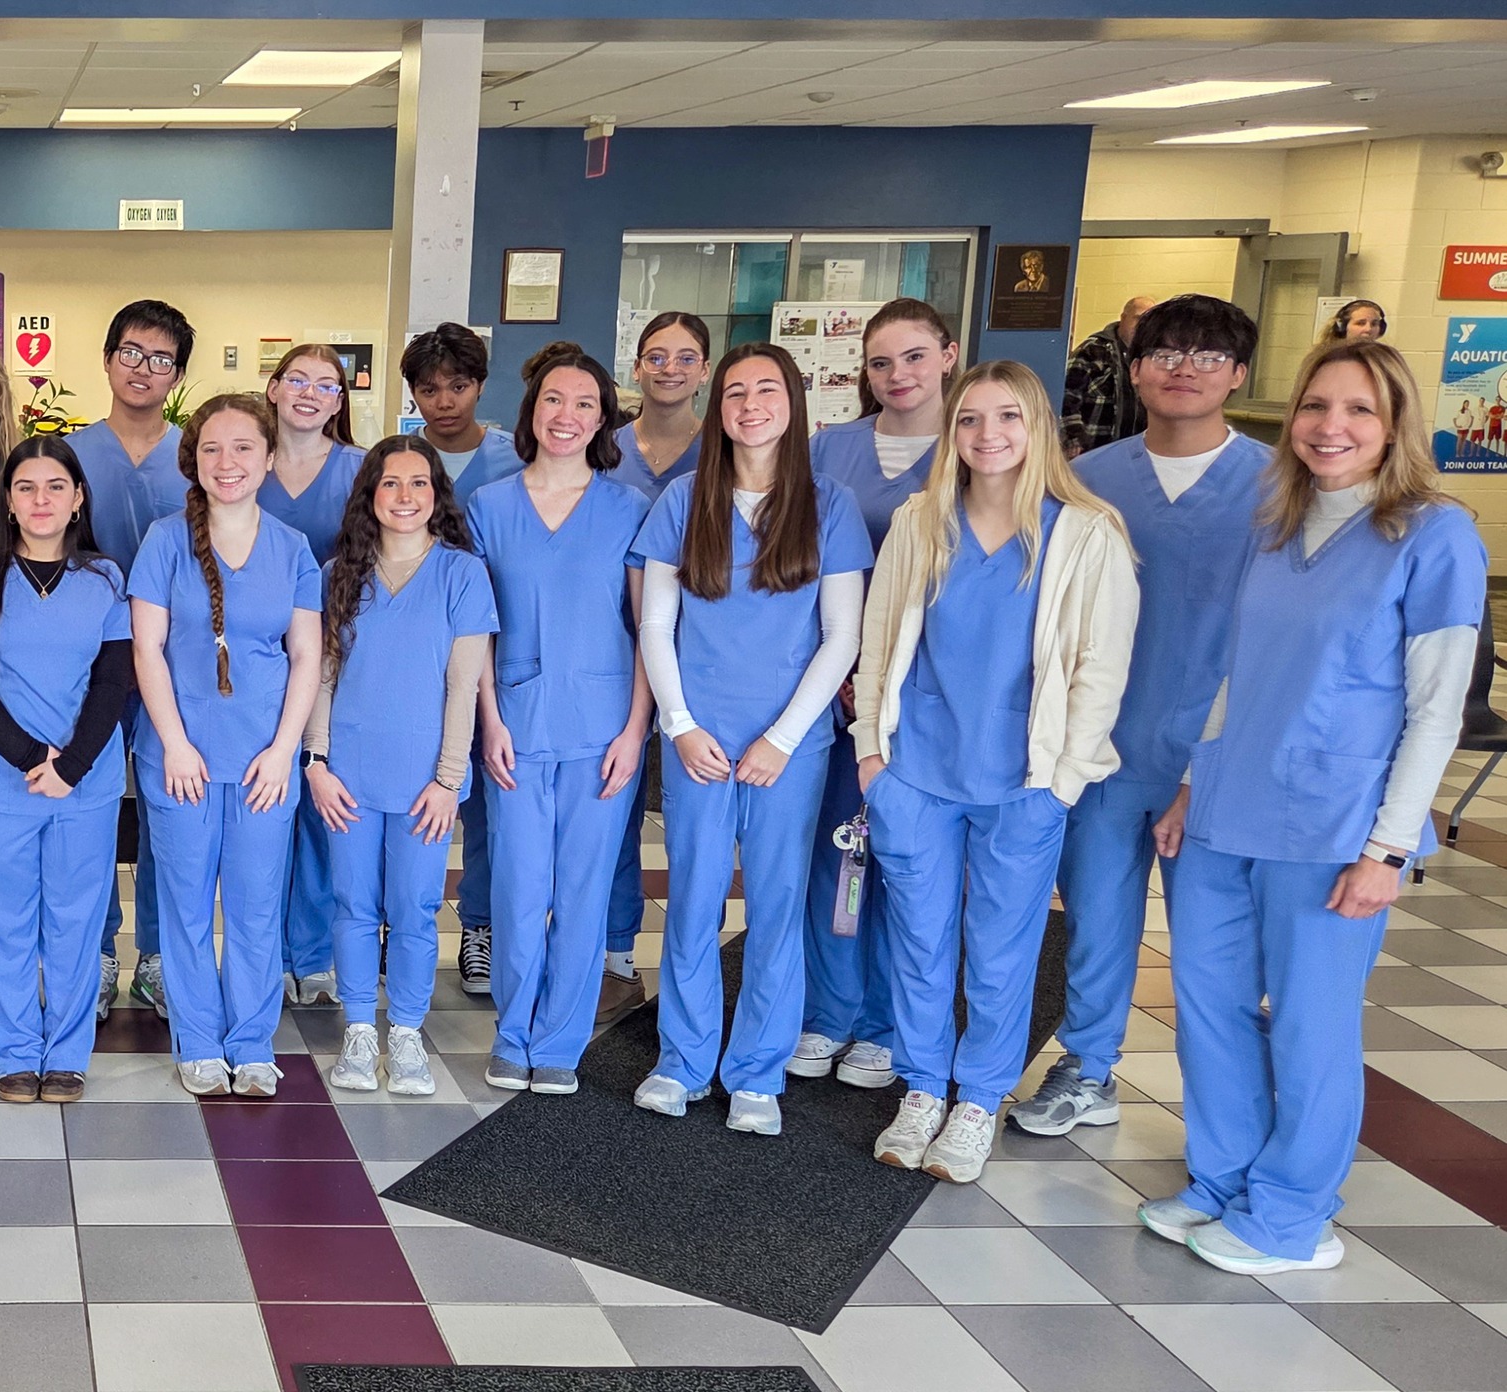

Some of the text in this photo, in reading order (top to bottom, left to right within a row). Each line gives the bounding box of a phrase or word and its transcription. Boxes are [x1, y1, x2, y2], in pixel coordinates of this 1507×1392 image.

[127, 207, 177, 221] OXYGEN OXYGEN
[18, 316, 50, 330] AED
[1444, 461, 1465, 470] JOIN
[1466, 461, 1486, 470] OUR
